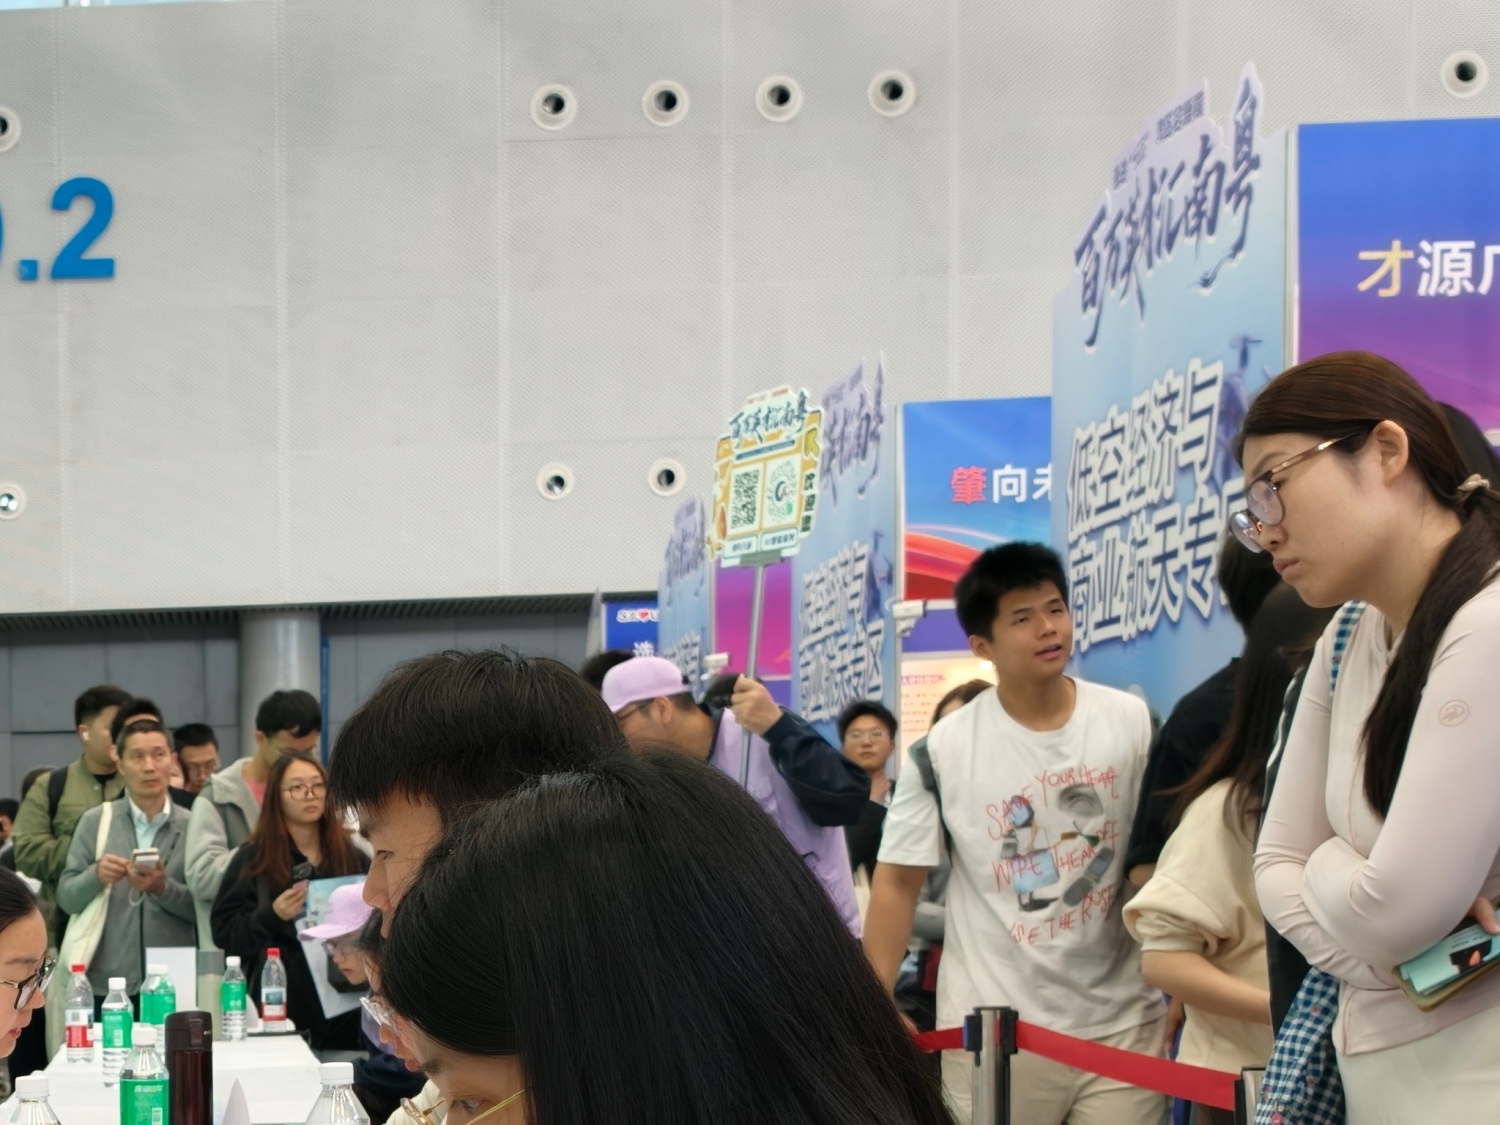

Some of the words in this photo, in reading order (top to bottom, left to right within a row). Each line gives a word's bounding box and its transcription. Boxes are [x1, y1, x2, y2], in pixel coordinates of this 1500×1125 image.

[1067, 356, 1224, 545] 低空经济与
[1035, 767, 1076, 809] YOUR
[992, 852, 1043, 893] WIPE
[1044, 909, 1077, 940] THE
